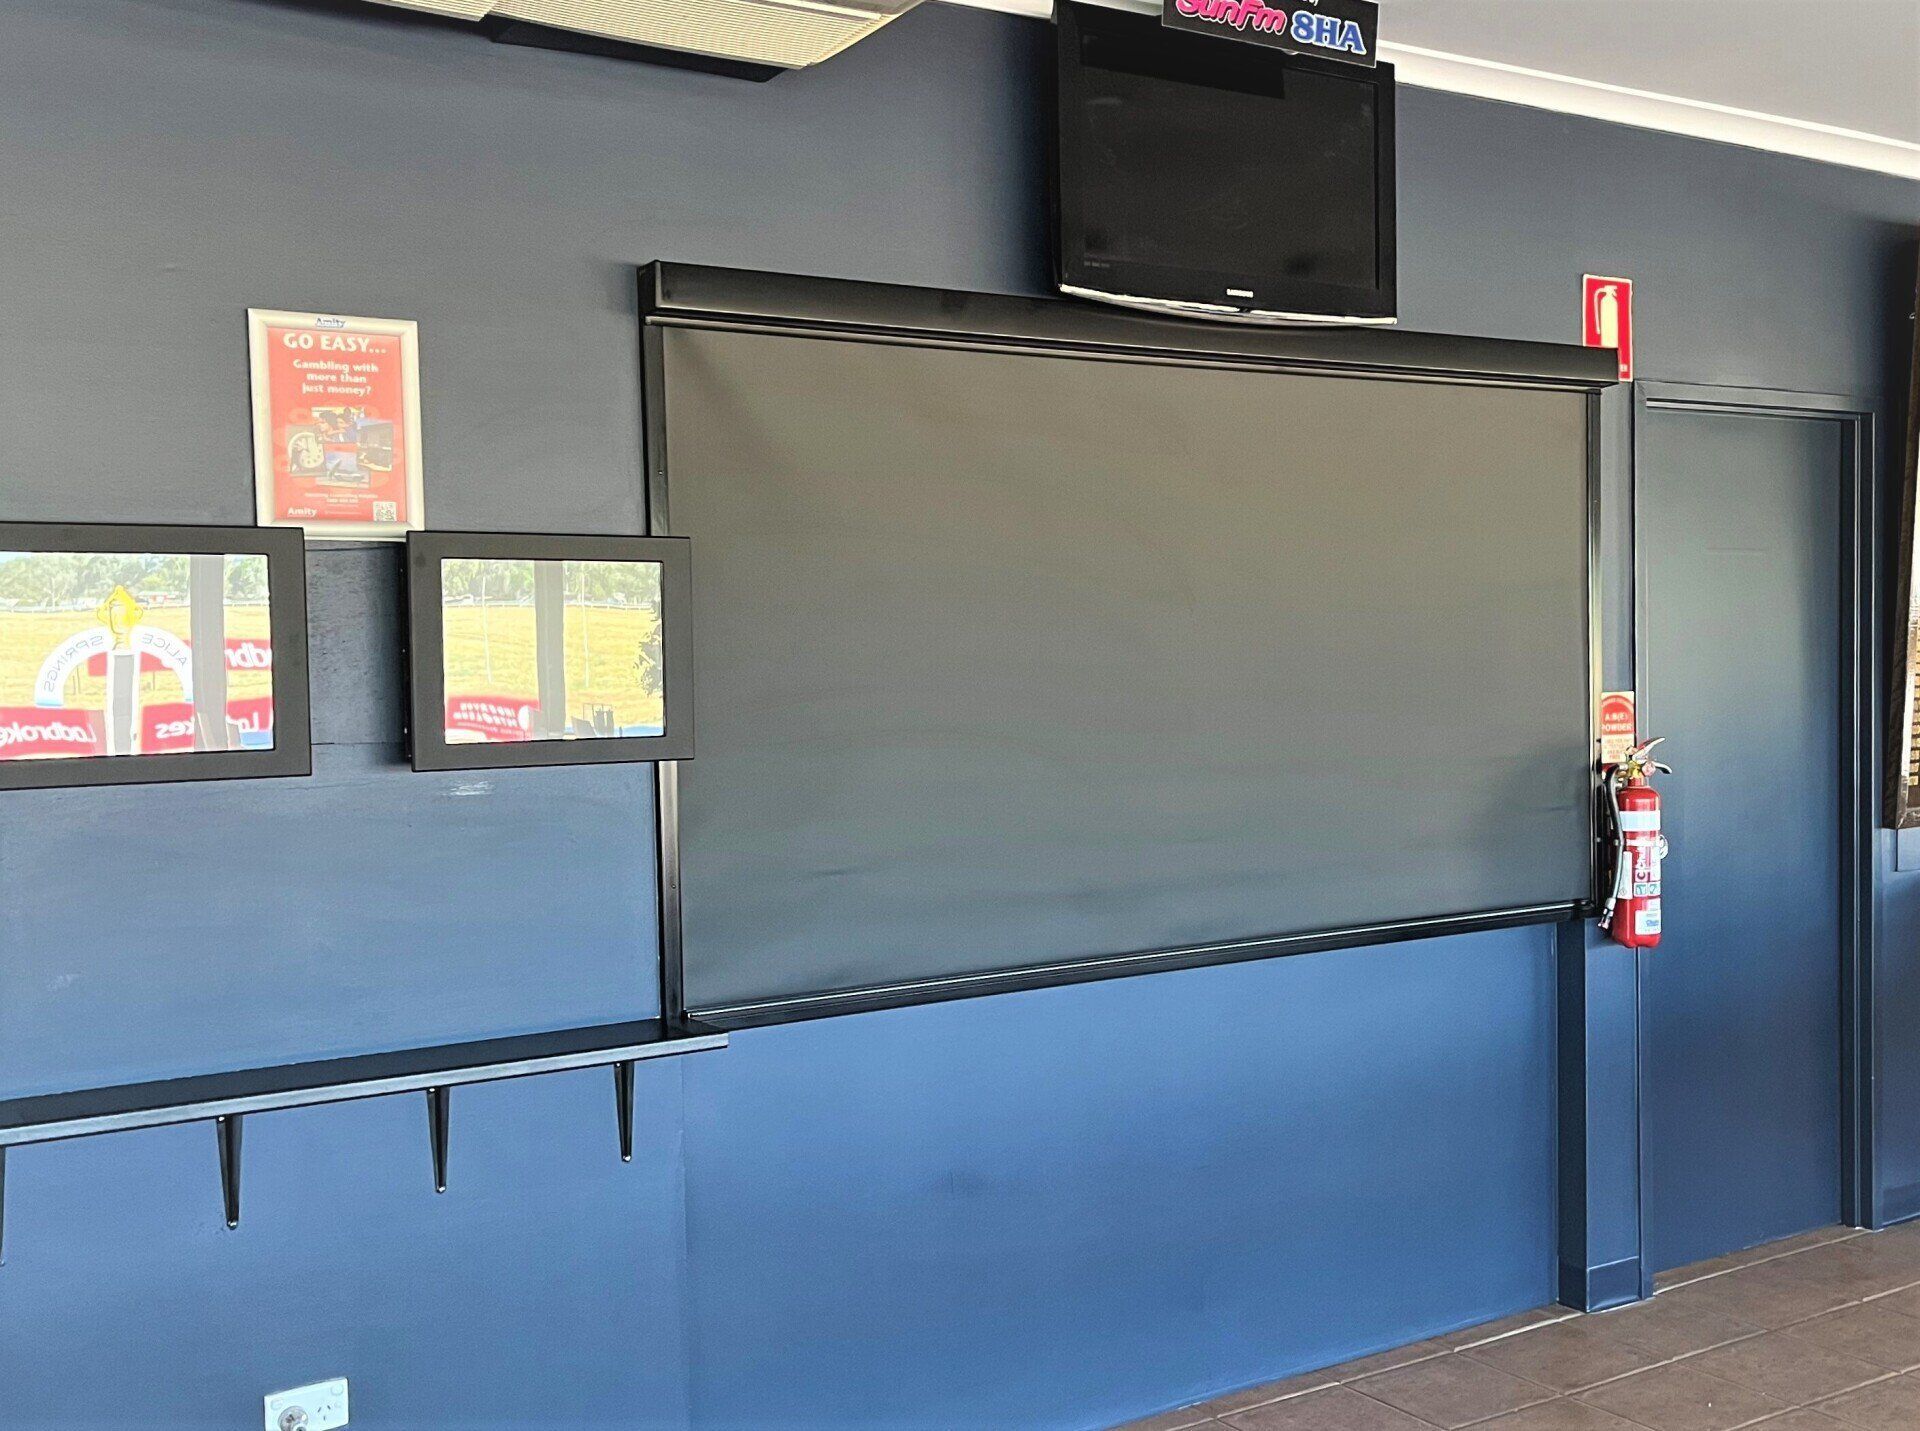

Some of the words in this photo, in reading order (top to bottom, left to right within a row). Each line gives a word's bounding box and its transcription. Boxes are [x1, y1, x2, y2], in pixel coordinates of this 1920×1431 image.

[1291, 10, 1367, 55] 8HA
[283, 332, 314, 349] GO
[320, 335, 387, 354] EASY...
[293, 359, 350, 373] Gambling
[353, 362, 379, 373] with
[307, 373, 336, 382] more
[340, 373, 367, 383] than
[302, 384, 324, 395] just
[327, 385, 372, 397] money?
[287, 507, 318, 518] Amity
